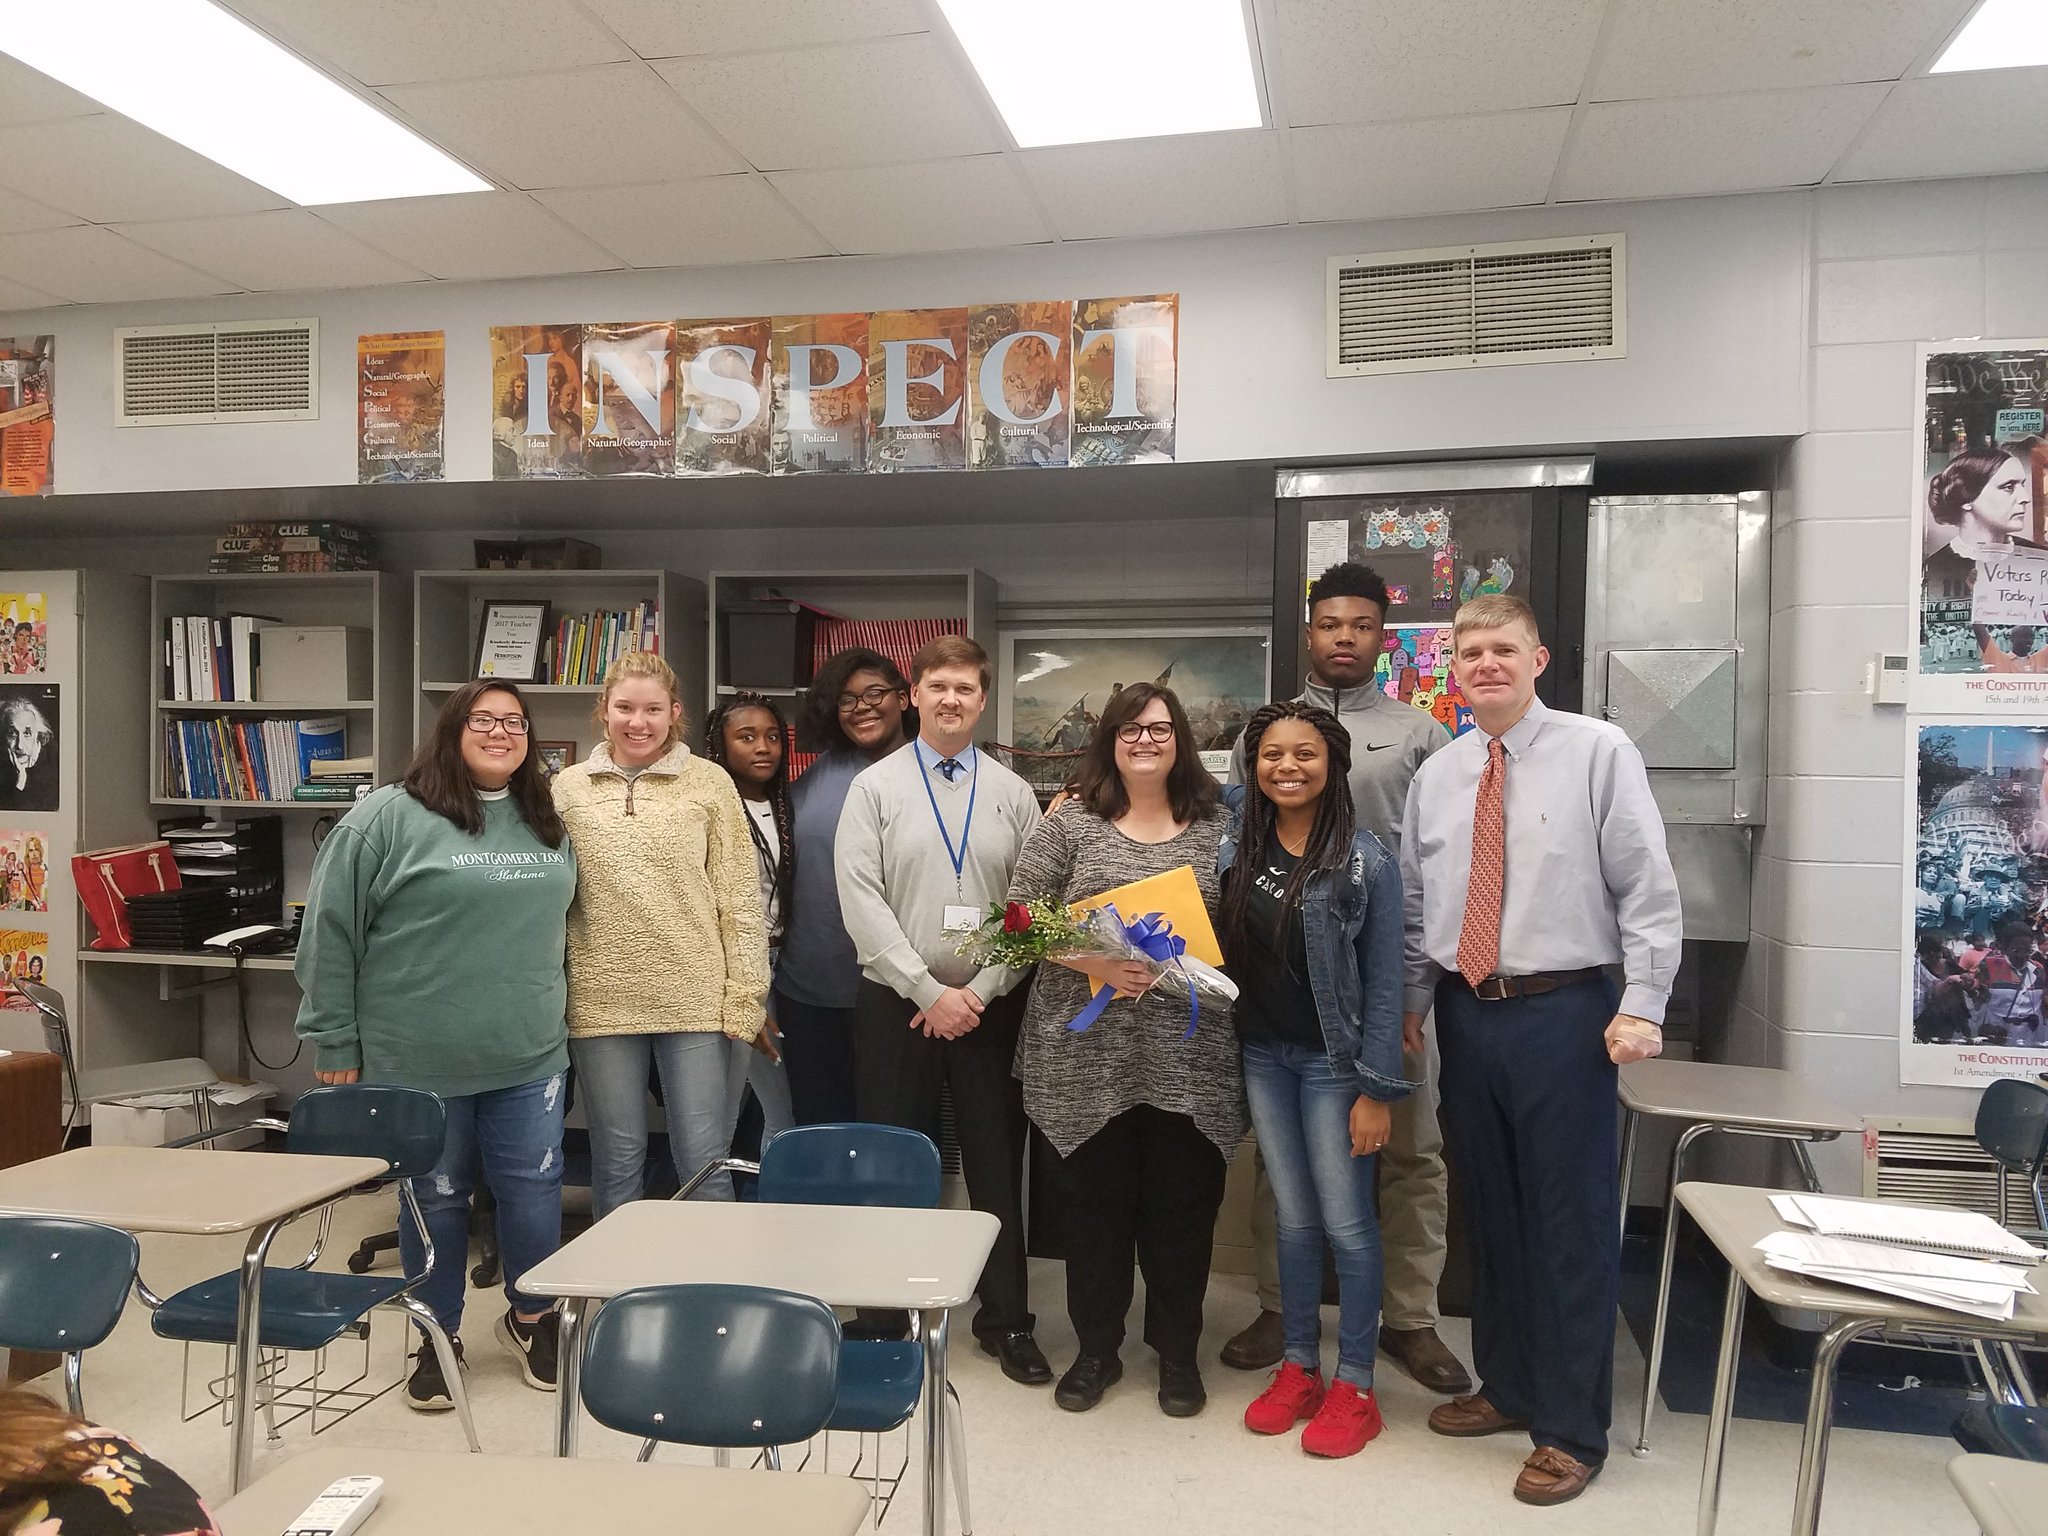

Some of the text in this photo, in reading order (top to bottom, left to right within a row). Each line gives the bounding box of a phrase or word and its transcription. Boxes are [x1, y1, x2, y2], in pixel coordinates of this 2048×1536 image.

[366, 354, 384, 365] Ideas
[363, 369, 431, 382] Natural/Geographic
[363, 385, 388, 397] Social
[363, 401, 391, 412] Political
[1999, 411, 2042, 421] REGISTER
[363, 416, 401, 429] Economic
[1075, 419, 1174, 434] Technological/Scientific
[2022, 422, 2041, 432] HERE
[896, 430, 941, 440] Economic
[1000, 425, 1039, 436] Cultural
[363, 432, 396, 445] Cultural
[527, 438, 549, 448] Ideas
[588, 436, 672, 449] Natural/Geographic
[711, 435, 737, 445] Social
[802, 432, 838, 443] Political
[363, 448, 442, 461] Technological/Scientific
[278, 525, 309, 536] CLUE
[222, 540, 250, 550] CLUE
[262, 554, 280, 562] Clue
[261, 564, 279, 572] Clue
[1984, 562, 2032, 582] Voters
[1996, 588, 2035, 608] Today
[1945, 611, 1969, 621] UNITED
[1965, 681, 1984, 690] THE
[1985, 695, 2001, 704] 15th
[2003, 695, 2020, 704] and
[2022, 695, 2040, 704] 19th
[451, 852, 565, 867] MONTGOMERY ZOO
[485, 867, 548, 882] Alabama
[1957, 1053, 1977, 1062] THE
[1953, 1067, 1963, 1075] 1st
[1967, 1067, 2016, 1078] Amendment
